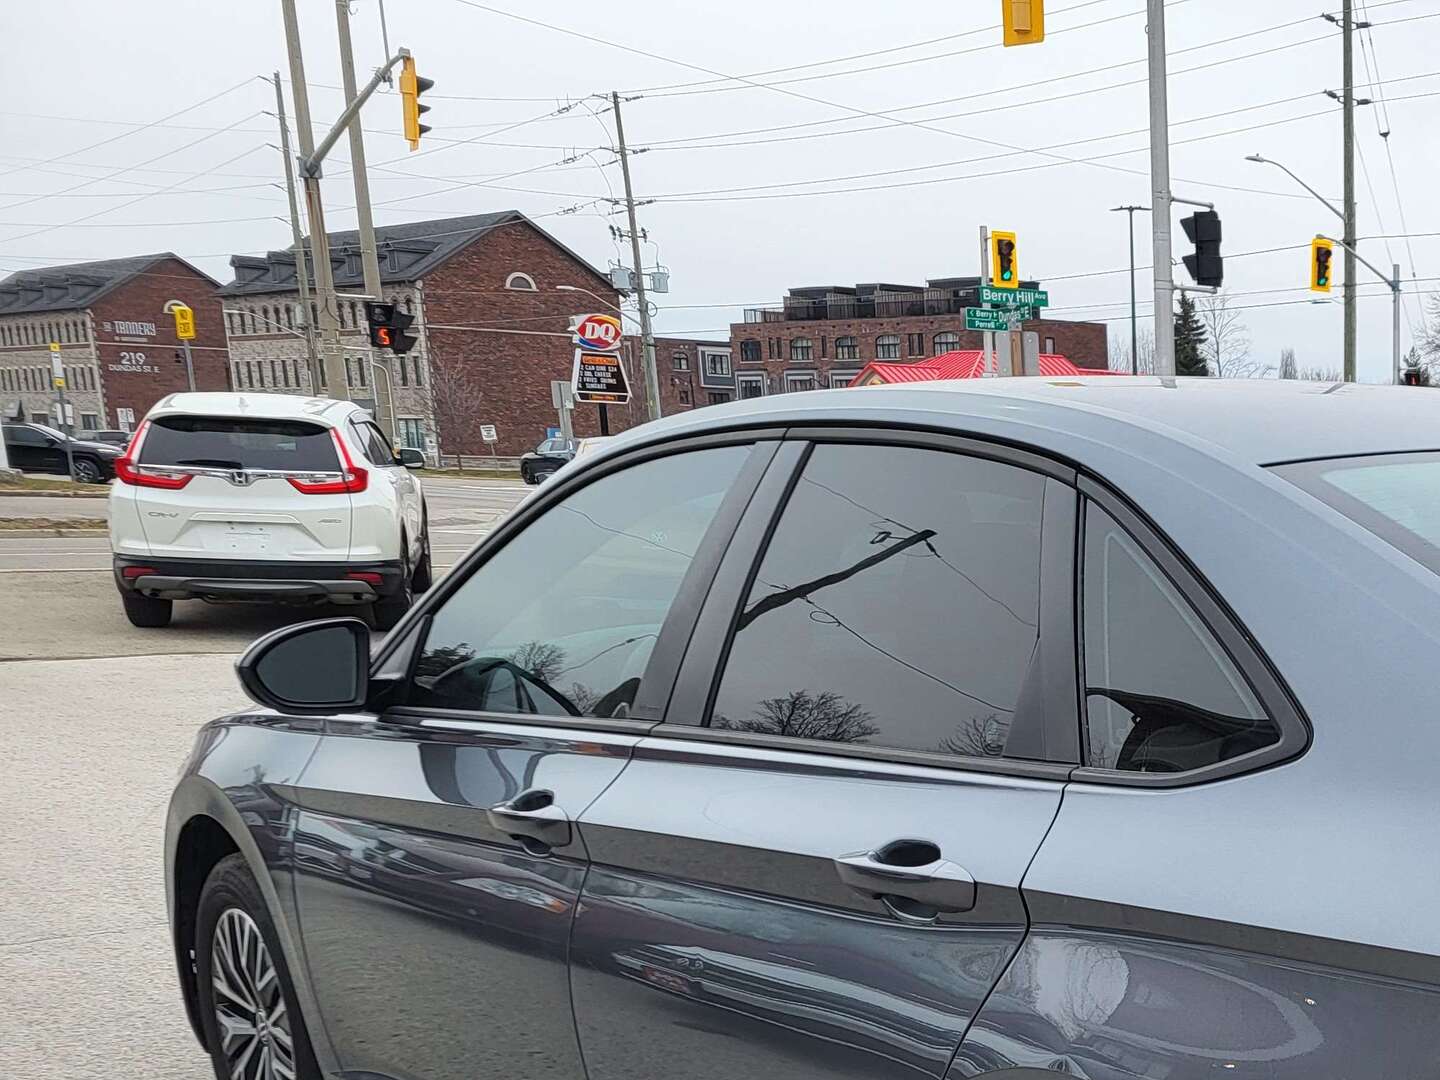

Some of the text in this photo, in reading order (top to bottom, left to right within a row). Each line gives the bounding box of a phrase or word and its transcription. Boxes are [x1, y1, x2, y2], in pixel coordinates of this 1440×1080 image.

[982, 288, 1046, 305] Berry Hill Ave
[976, 310, 992, 319] Berry
[998, 309, 1021, 323] Dundas
[113, 321, 156, 336] TANNERY
[584, 322, 615, 343] DQ
[120, 352, 146, 365] 219
[108, 364, 142, 373] DUNDAS
